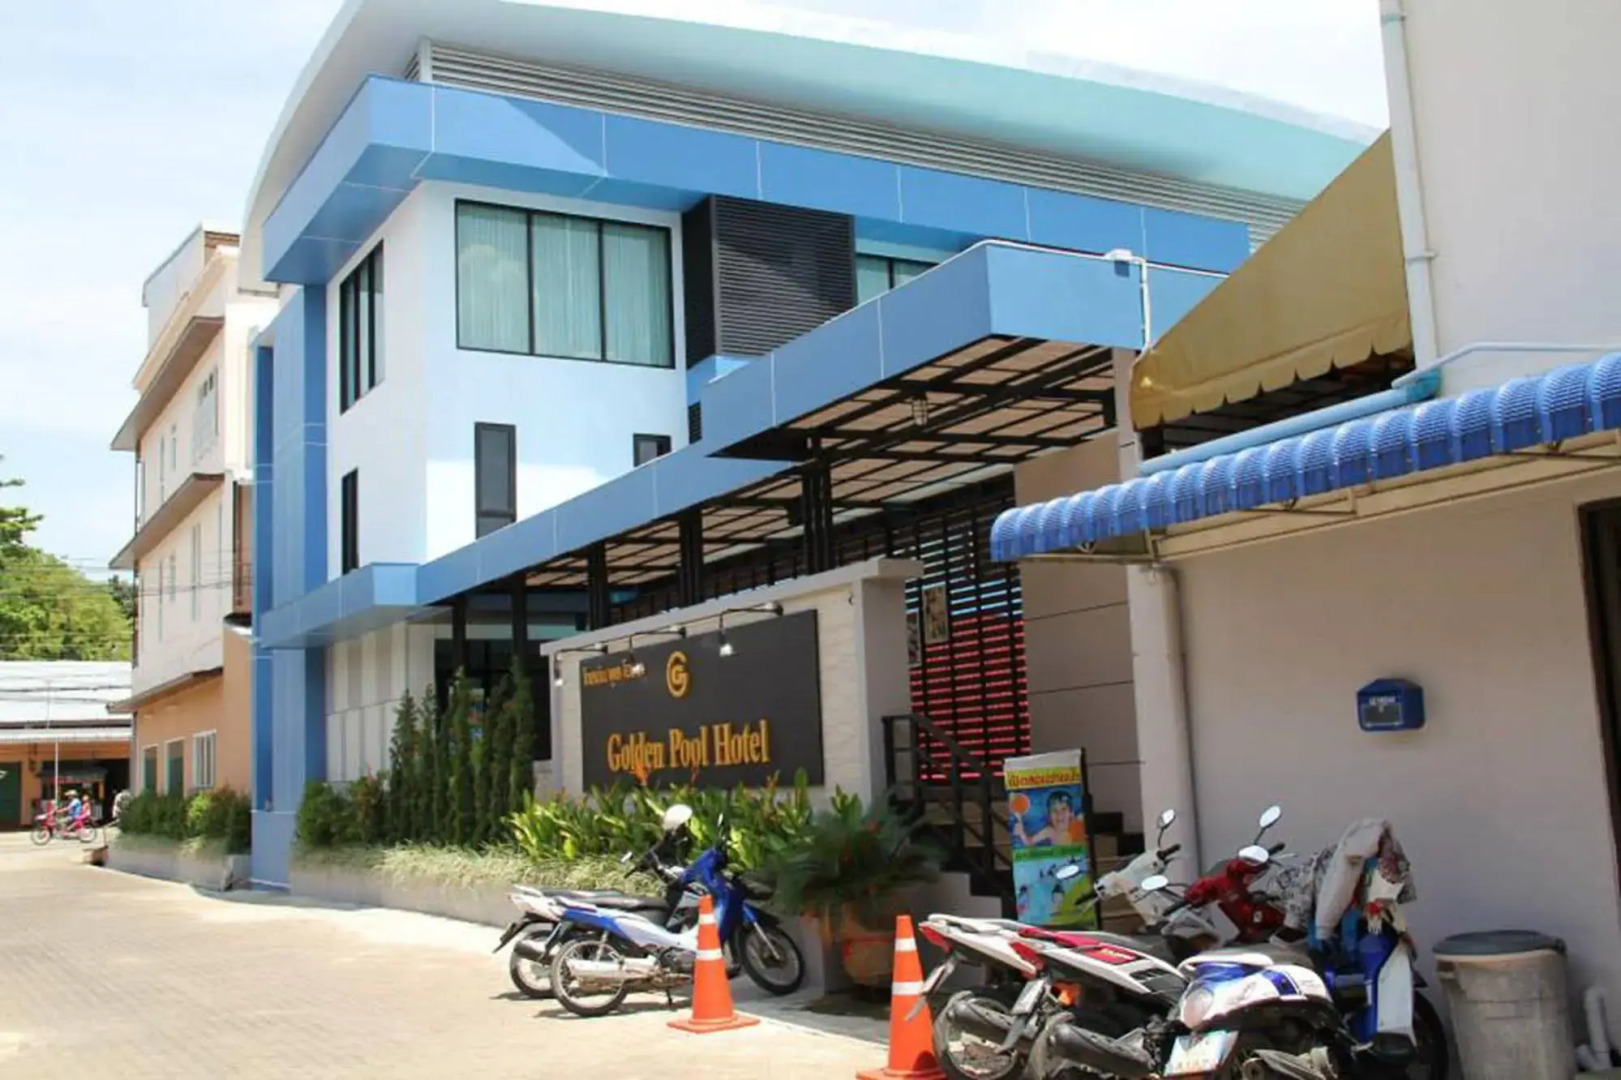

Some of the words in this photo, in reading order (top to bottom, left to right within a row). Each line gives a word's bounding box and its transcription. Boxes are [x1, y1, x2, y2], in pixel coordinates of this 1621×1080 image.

[607, 731, 665, 772] Golden
[669, 726, 709, 768] Pool
[712, 719, 770, 766] Hotel
